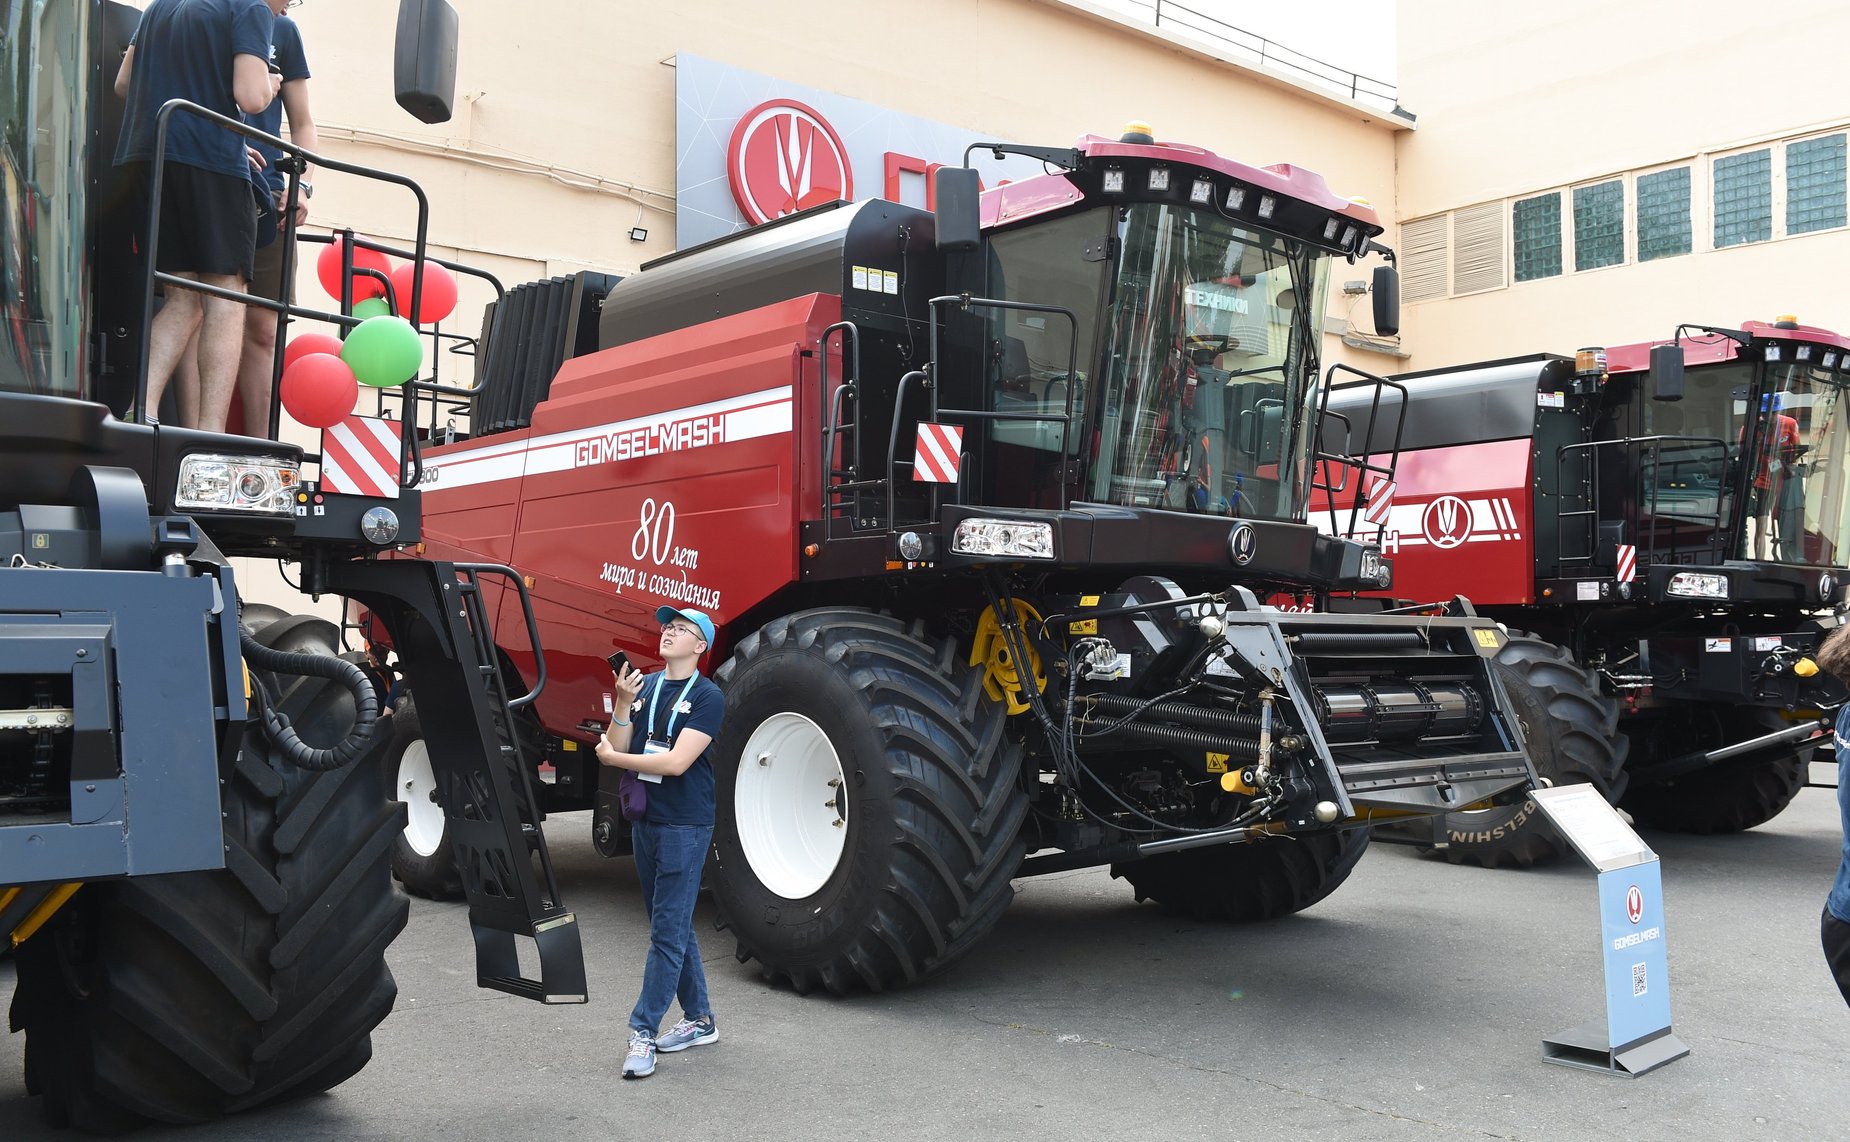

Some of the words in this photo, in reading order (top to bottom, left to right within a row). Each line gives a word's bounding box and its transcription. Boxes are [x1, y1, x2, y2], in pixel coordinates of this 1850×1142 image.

[575, 414, 725, 467] GOMSELMASH
[631, 498, 675, 565] 80
[671, 546, 698, 570] лет
[600, 562, 635, 594] мира
[637, 570, 647, 591] и
[649, 569, 721, 610] созидания
[1447, 800, 1537, 843] BELSHIN
[1614, 926, 1660, 950] GOMSELMASH
